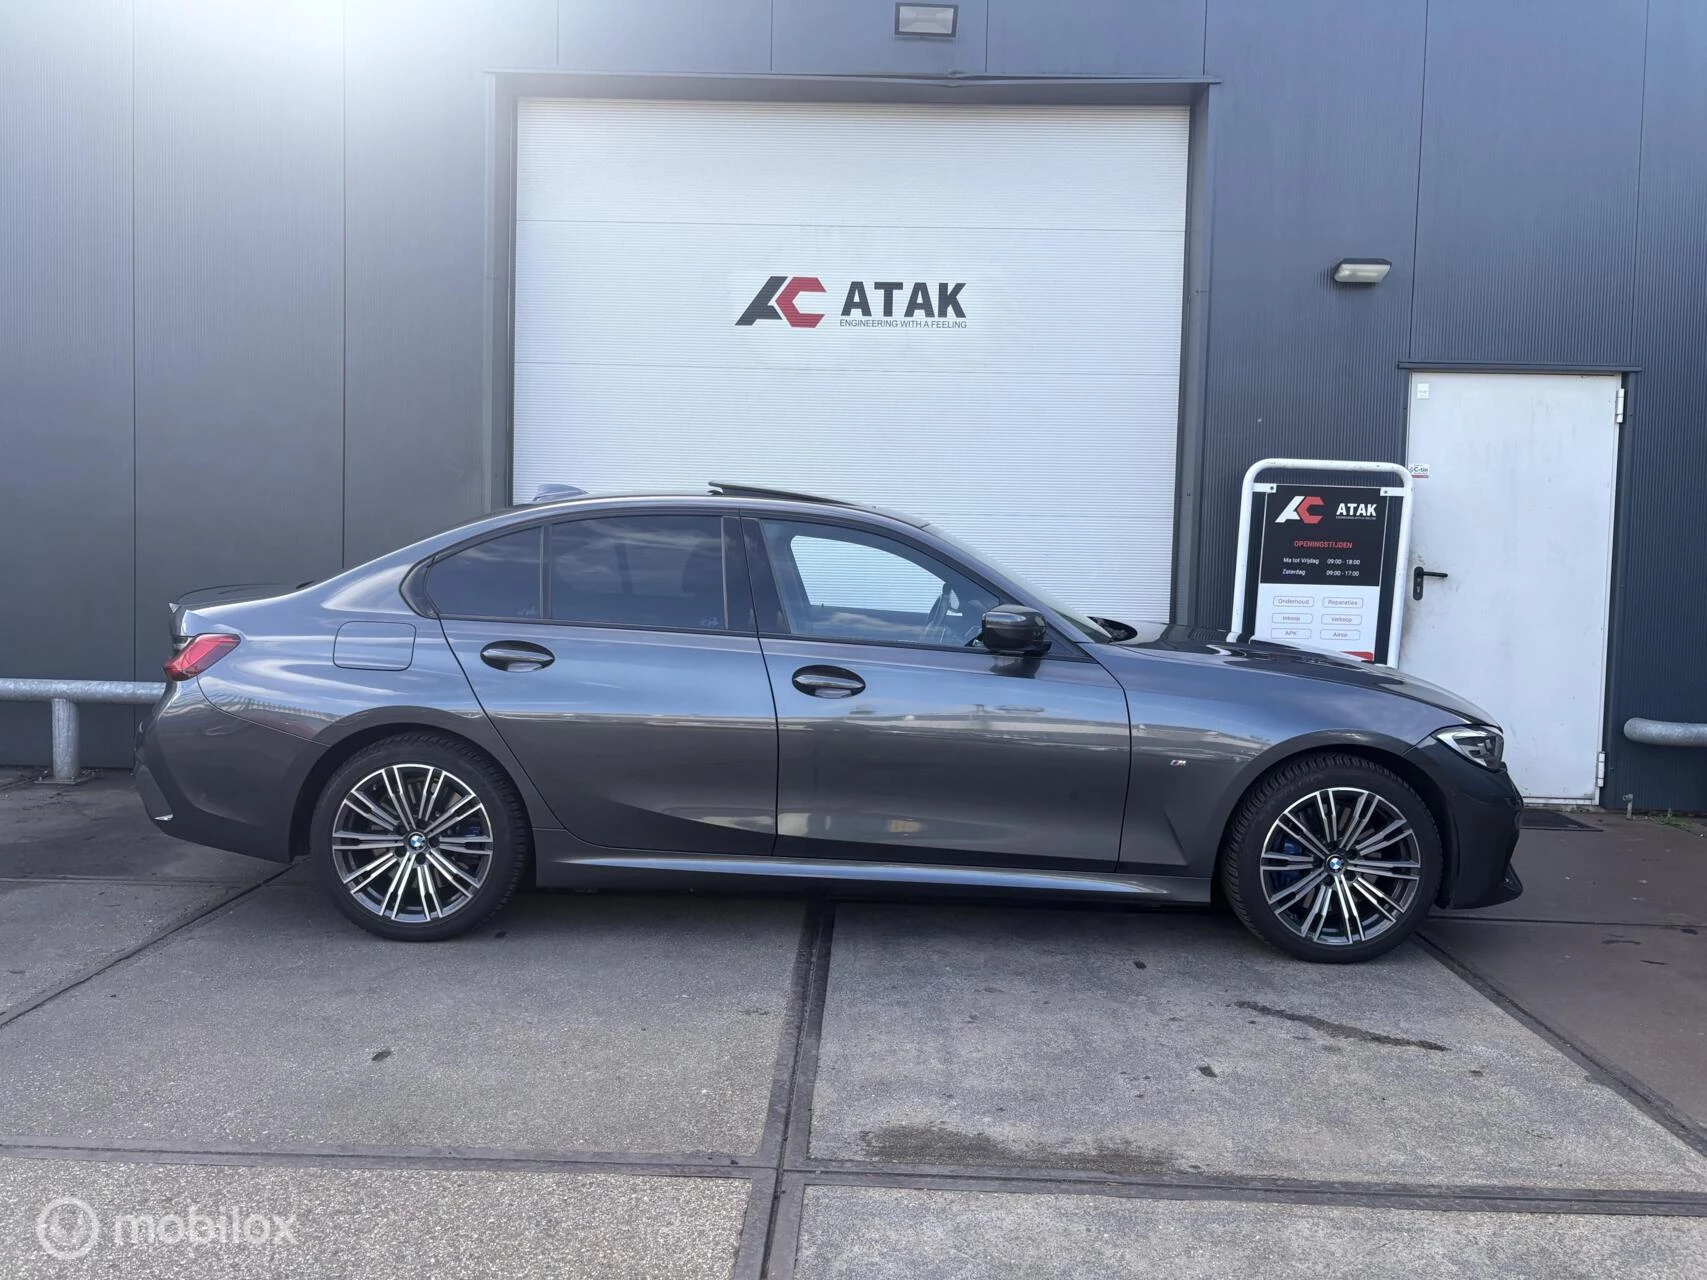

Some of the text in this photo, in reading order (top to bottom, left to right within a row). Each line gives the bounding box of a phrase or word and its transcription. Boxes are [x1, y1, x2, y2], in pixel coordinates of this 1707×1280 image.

[841, 281, 967, 318] ATAK
[839, 319, 898, 328] ENGINEERING
[900, 320, 922, 328] WITH
[931, 321, 967, 329] FEELING
[1336, 503, 1377, 516] ATAK
